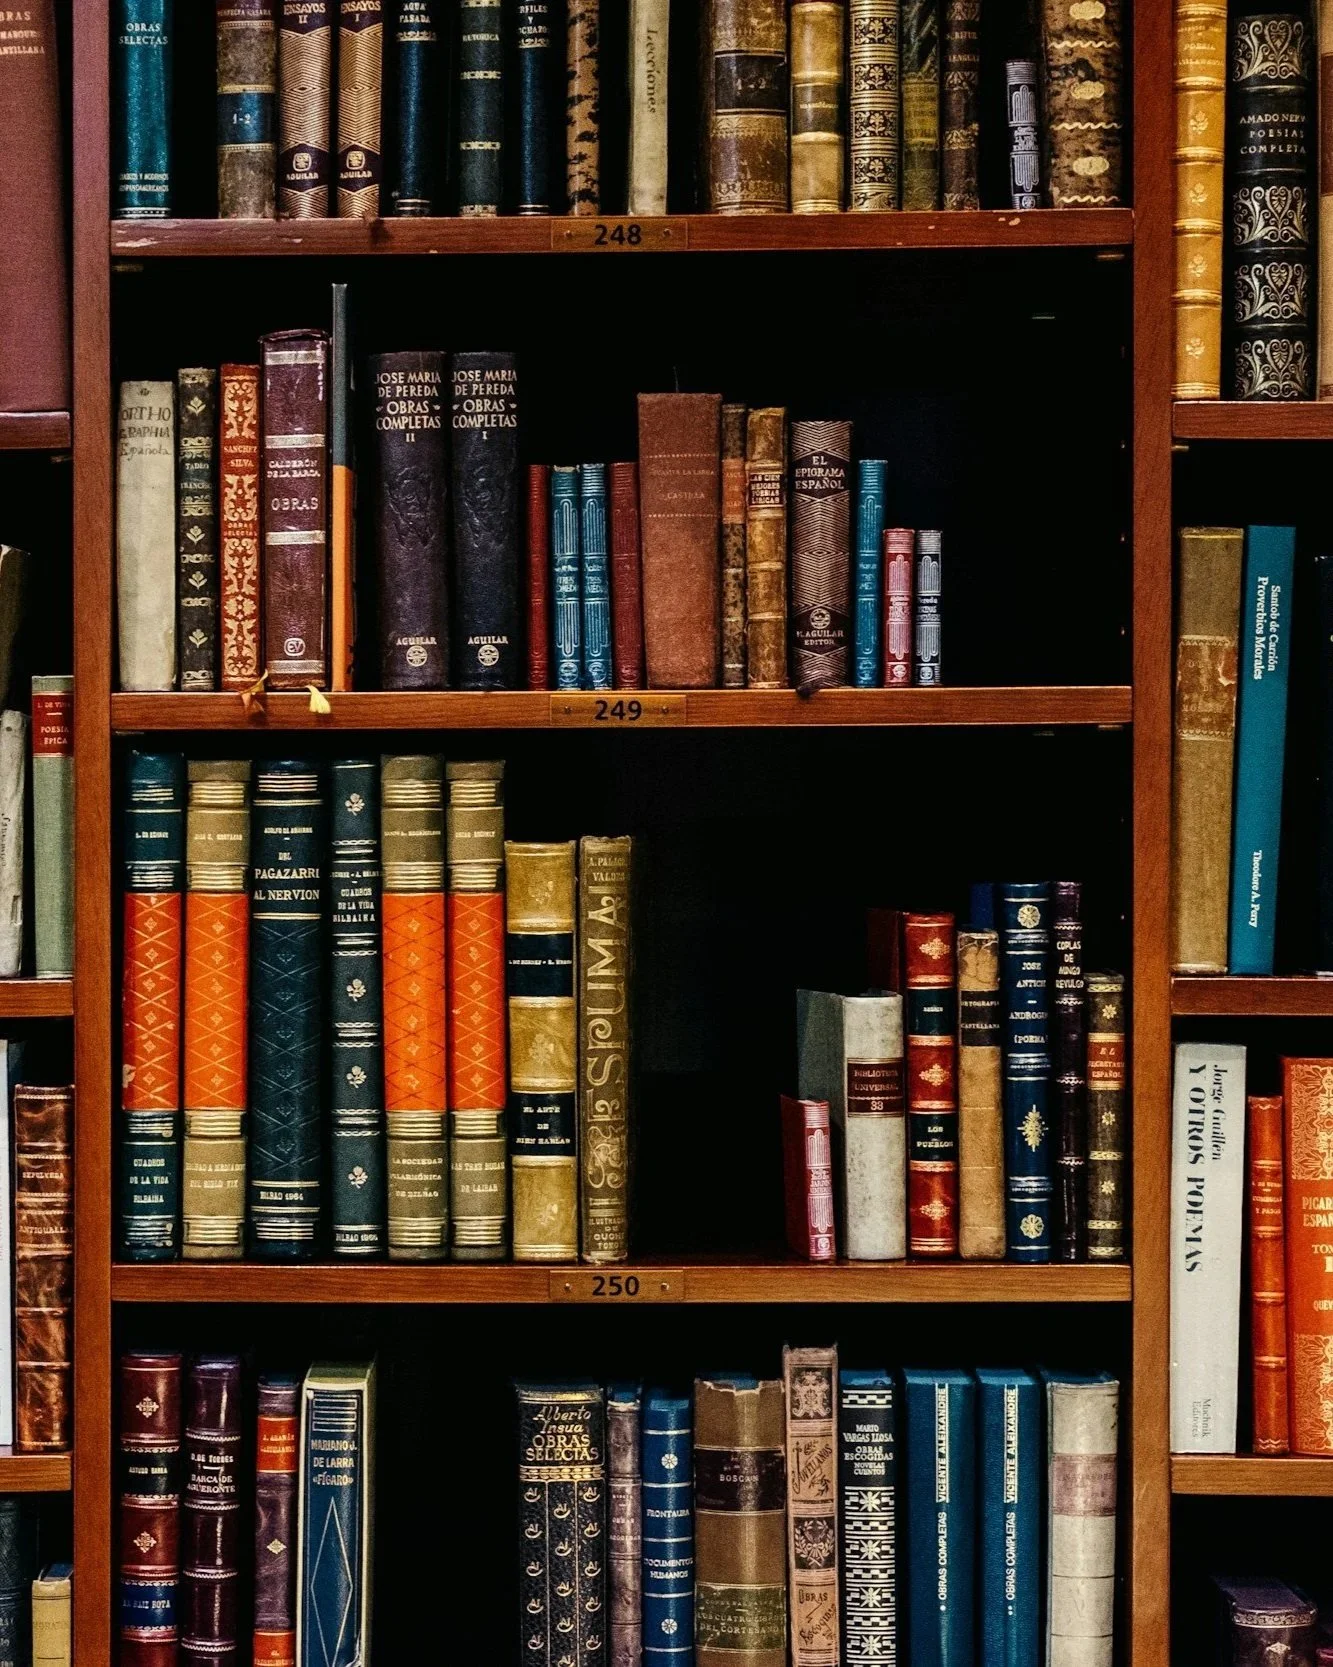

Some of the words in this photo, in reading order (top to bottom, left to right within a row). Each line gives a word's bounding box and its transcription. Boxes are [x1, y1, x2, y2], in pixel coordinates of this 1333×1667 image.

[284, 3, 326, 15] ENSAYOS
[341, 1, 382, 13] ENSAYOS
[299, 15, 308, 23] II
[126, 23, 160, 32] OBRAS
[119, 36, 168, 45] SELECTAS
[1240, 114, 1279, 124] AMADO
[594, 224, 642, 246] 248
[375, 372, 405, 385] JOSE
[407, 371, 441, 384] MARIA
[451, 370, 481, 382] JOSE
[484, 369, 518, 382] MARIA
[378, 386, 391, 398] DE
[396, 385, 439, 398] PEREDA
[454, 384, 468, 396] DE
[472, 383, 515, 396] PEREDA
[386, 400, 430, 415] OBRAS
[463, 399, 506, 413] OBRAS
[376, 415, 441, 431] COMPLETAS
[452, 414, 517, 428] COMPLETAS
[405, 432, 416, 443] II
[482, 430, 488, 440] I
[269, 459, 318, 469] CALDERÓN
[812, 456, 828, 465] EL
[267, 469, 278, 478] DE
[279, 469, 290, 478] LA
[795, 468, 846, 478] EPIGRAMA
[795, 478, 845, 490] ESPAÑOL
[271, 497, 319, 511] OBRAS
[1255, 576, 1269, 636] Proverbios
[1269, 585, 1281, 620] Santob
[1269, 621, 1280, 633] de
[395, 636, 437, 645] AGUILAR
[467, 635, 508, 645] AGUILAR
[804, 638, 835, 646] EDITOR
[1253, 636, 1267, 680] Morales
[1267, 634, 1280, 672] Carrión
[594, 700, 642, 721] 249
[278, 852, 292, 860] DEL
[255, 867, 320, 880] PAGAZARRI
[1251, 849, 1263, 890] Theodore
[254, 889, 266, 901] AL
[267, 888, 320, 901] NERVION
[1251, 891, 1261, 902] A.
[358, 902, 375, 910] VIDA
[1249, 903, 1260, 928] Perry
[1056, 940, 1082, 951] COPLAS
[1063, 953, 1074, 963] DE
[1058, 965, 1081, 976] MINGO
[1055, 979, 1085, 989] REVULGO
[1187, 1063, 1208, 1075] Y
[1210, 1064, 1228, 1105] Jorge
[522, 1106, 534, 1114] EL
[536, 1105, 561, 1114] ARTE
[870, 1100, 884, 1111] 33
[1186, 1086, 1207, 1166] OTROS
[1211, 1108, 1227, 1161] Guillén
[916, 1140, 954, 1149] PUEBLOS
[133, 1158, 165, 1167] CUADROS
[401, 1157, 443, 1166] SOCIEDAD
[22, 1170, 65, 1180] SEPULVEDA
[129, 1176, 139, 1184] DE
[140, 1176, 151, 1184] LA
[153, 1176, 170, 1184] VIDA
[259, 1190, 283, 1201] BILBAO
[1184, 1176, 1206, 1273] POEMAS
[335, 1233, 359, 1243] BILBAO
[592, 1276, 640, 1296] 250
[532, 1404, 592, 1422] Alberto
[937, 1388, 947, 1454] ALEIXANDRE
[1005, 1388, 1016, 1455] ALEIXANDRE
[539, 1421, 585, 1434] Insua
[855, 1424, 880, 1433] MARIO
[532, 1434, 591, 1449] OBRAS
[843, 1432, 870, 1443] VARGAS
[870, 1432, 895, 1443] LLOSA
[311, 1438, 348, 1451] MARIANO
[855, 1445, 884, 1454] OBRAS
[208, 1453, 234, 1463] TORRES
[525, 1447, 599, 1462] SELECTAS
[843, 1452, 894, 1461] ESCOGIDAS
[313, 1456, 325, 1468] DE
[326, 1457, 354, 1468] LARRA
[853, 1461, 886, 1469] NOVELAS
[853, 1468, 886, 1476] CUENTOS
[191, 1473, 218, 1484] BARCA
[221, 1475, 232, 1484] DE
[312, 1471, 354, 1486] «FÍGARO»
[937, 1458, 947, 1503] VICENTE
[1005, 1458, 1016, 1503] VICENTE
[646, 1508, 690, 1518] FRONTAURA
[937, 1511, 948, 1566] COMPLETAS
[1005, 1511, 1016, 1567] COMPLETAS
[650, 1570, 689, 1579] HUMANOS
[938, 1567, 948, 1601] OBRAS
[1005, 1568, 1016, 1601] OBRAS
[798, 1588, 829, 1604] OBRAS
